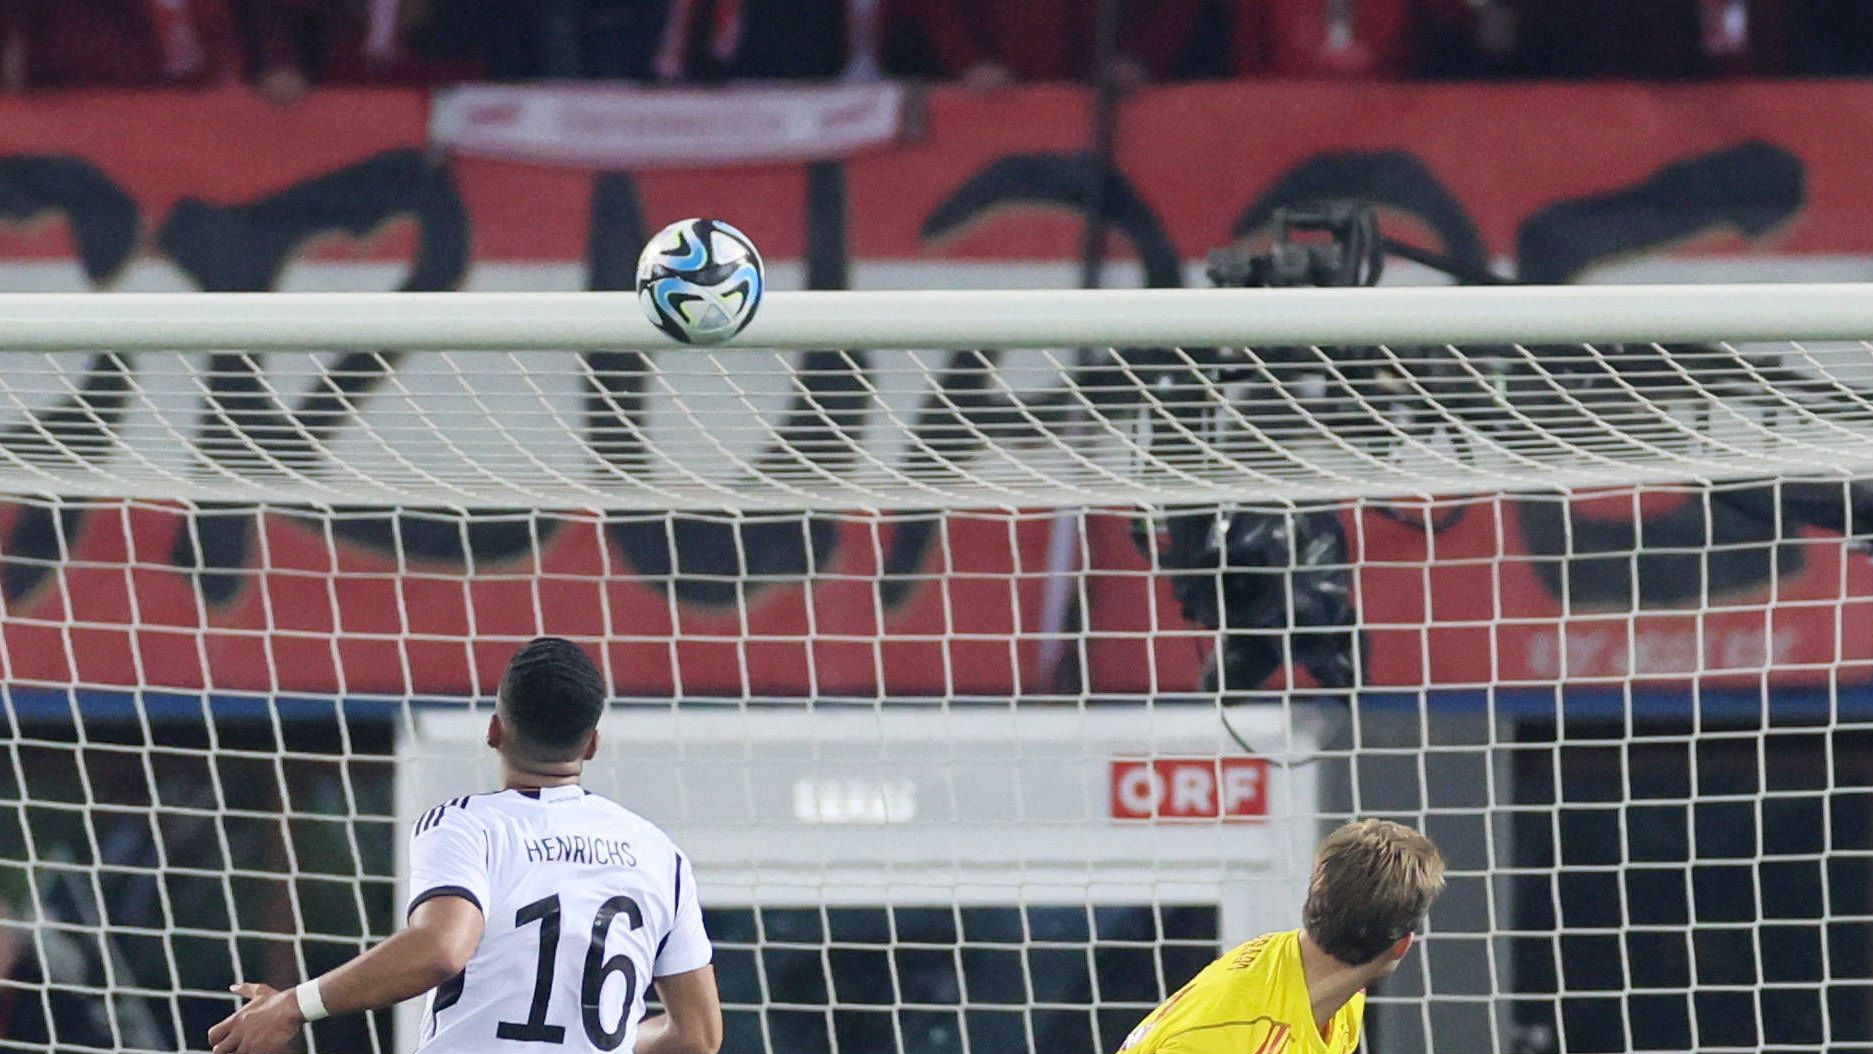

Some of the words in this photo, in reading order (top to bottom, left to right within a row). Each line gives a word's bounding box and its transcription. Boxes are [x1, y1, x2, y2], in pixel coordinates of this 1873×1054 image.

[1118, 766, 1258, 813] ORF
[523, 834, 638, 868] HENRICHS
[496, 893, 646, 1053] 16
